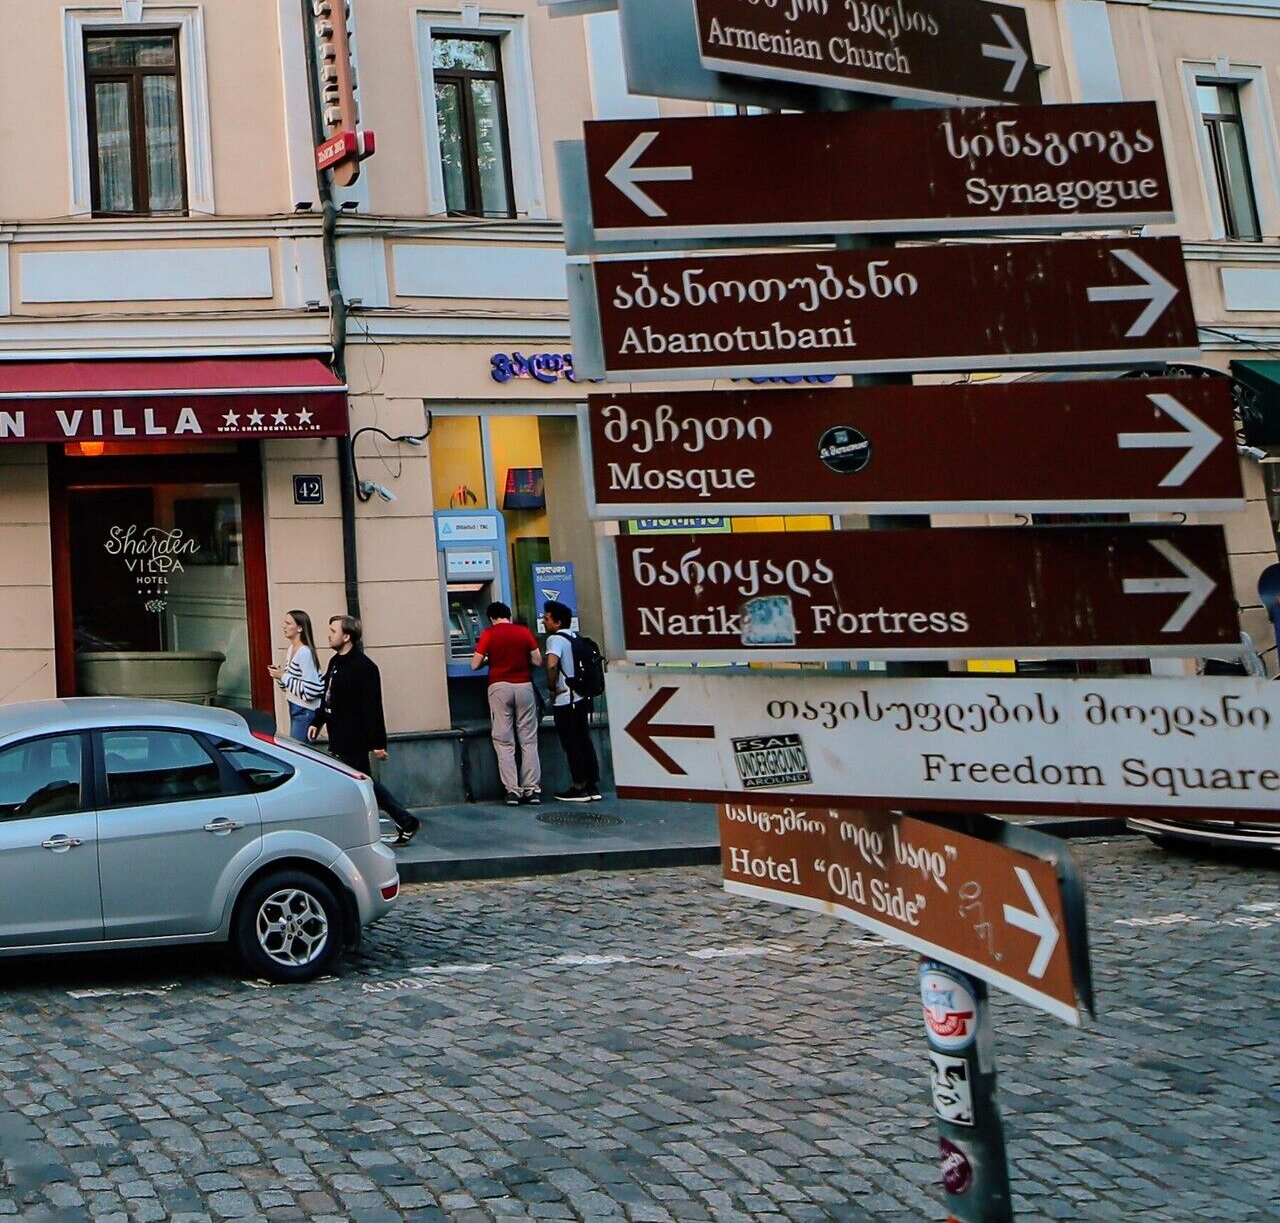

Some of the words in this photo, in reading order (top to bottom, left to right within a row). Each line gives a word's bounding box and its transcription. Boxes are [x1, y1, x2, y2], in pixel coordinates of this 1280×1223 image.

[707, 17, 823, 60] Armenian
[828, 36, 912, 74] Church
[942, 121, 1155, 167] სინაგოგა
[965, 177, 1159, 212] Synagogue
[613, 260, 918, 312] აბანოთუბანი
[618, 319, 856, 355] Abanotubani
[56, 407, 203, 438] VILLA
[601, 405, 773, 453] მეჩეთი
[299, 482, 320, 497] 42
[607, 462, 756, 497] Mosque
[104, 525, 201, 560] Sharden
[125, 559, 184, 572] VILLA
[136, 576, 169, 584] HOTEL
[632, 547, 834, 597] ნარიყალა
[810, 605, 969, 634] Fortress
[767, 690, 1059, 733] თავისუფლების
[1085, 692, 1270, 736] მოედანი
[736, 737, 799, 751] FSAL
[736, 746, 808, 778] UNDERGROUND
[922, 754, 1107, 786] Freedom
[1122, 758, 1280, 795] Square
[746, 773, 807, 787] AROUND
[725, 803, 826, 835] სასტუმრო
[729, 846, 801, 885] Hotel
